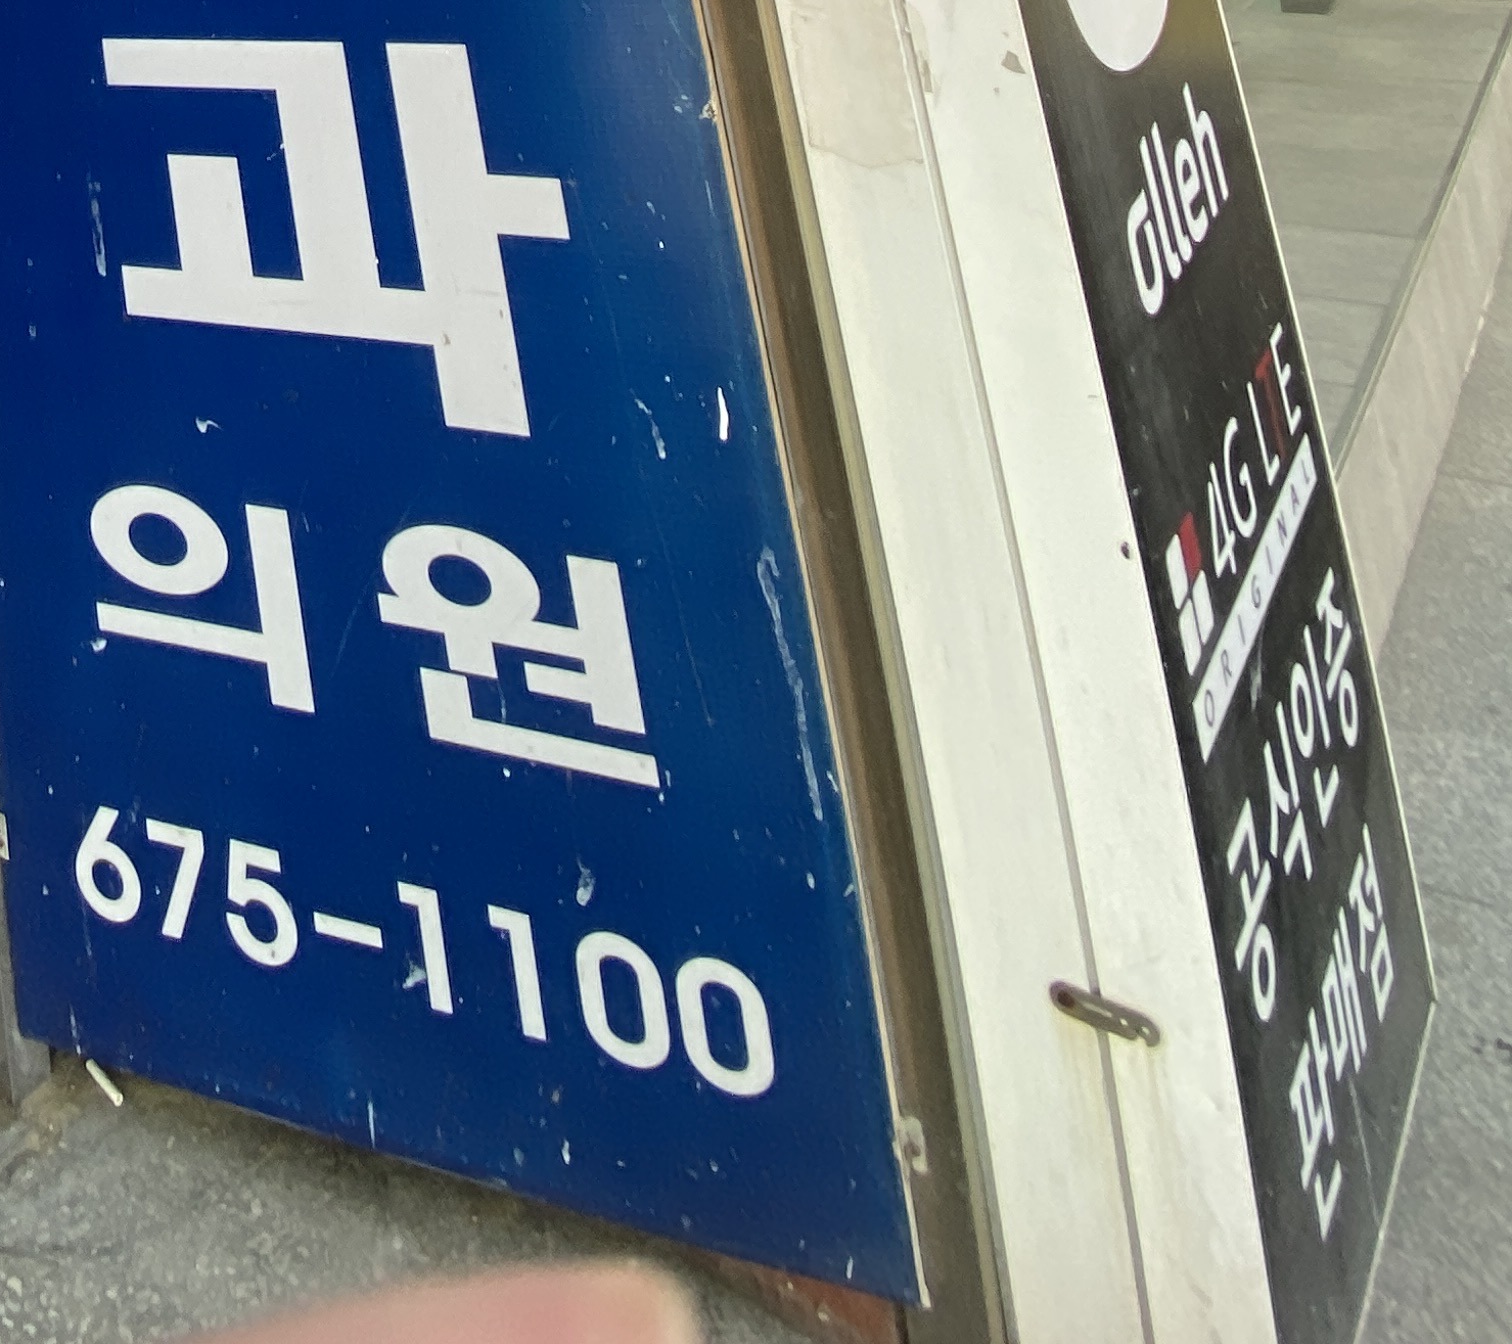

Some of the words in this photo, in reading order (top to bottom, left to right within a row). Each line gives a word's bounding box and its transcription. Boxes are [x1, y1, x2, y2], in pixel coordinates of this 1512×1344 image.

[1126, 81, 1230, 316] olleh
[1201, 450, 1317, 732] ORIGINAL
[1207, 414, 1257, 579] 4G
[1246, 320, 1303, 487] LTE
[88, 483, 661, 789] 의원
[1227, 565, 1359, 1023] 공식인증
[74, 806, 777, 1100] 675-1100
[1290, 821, 1395, 1242] 판매점
